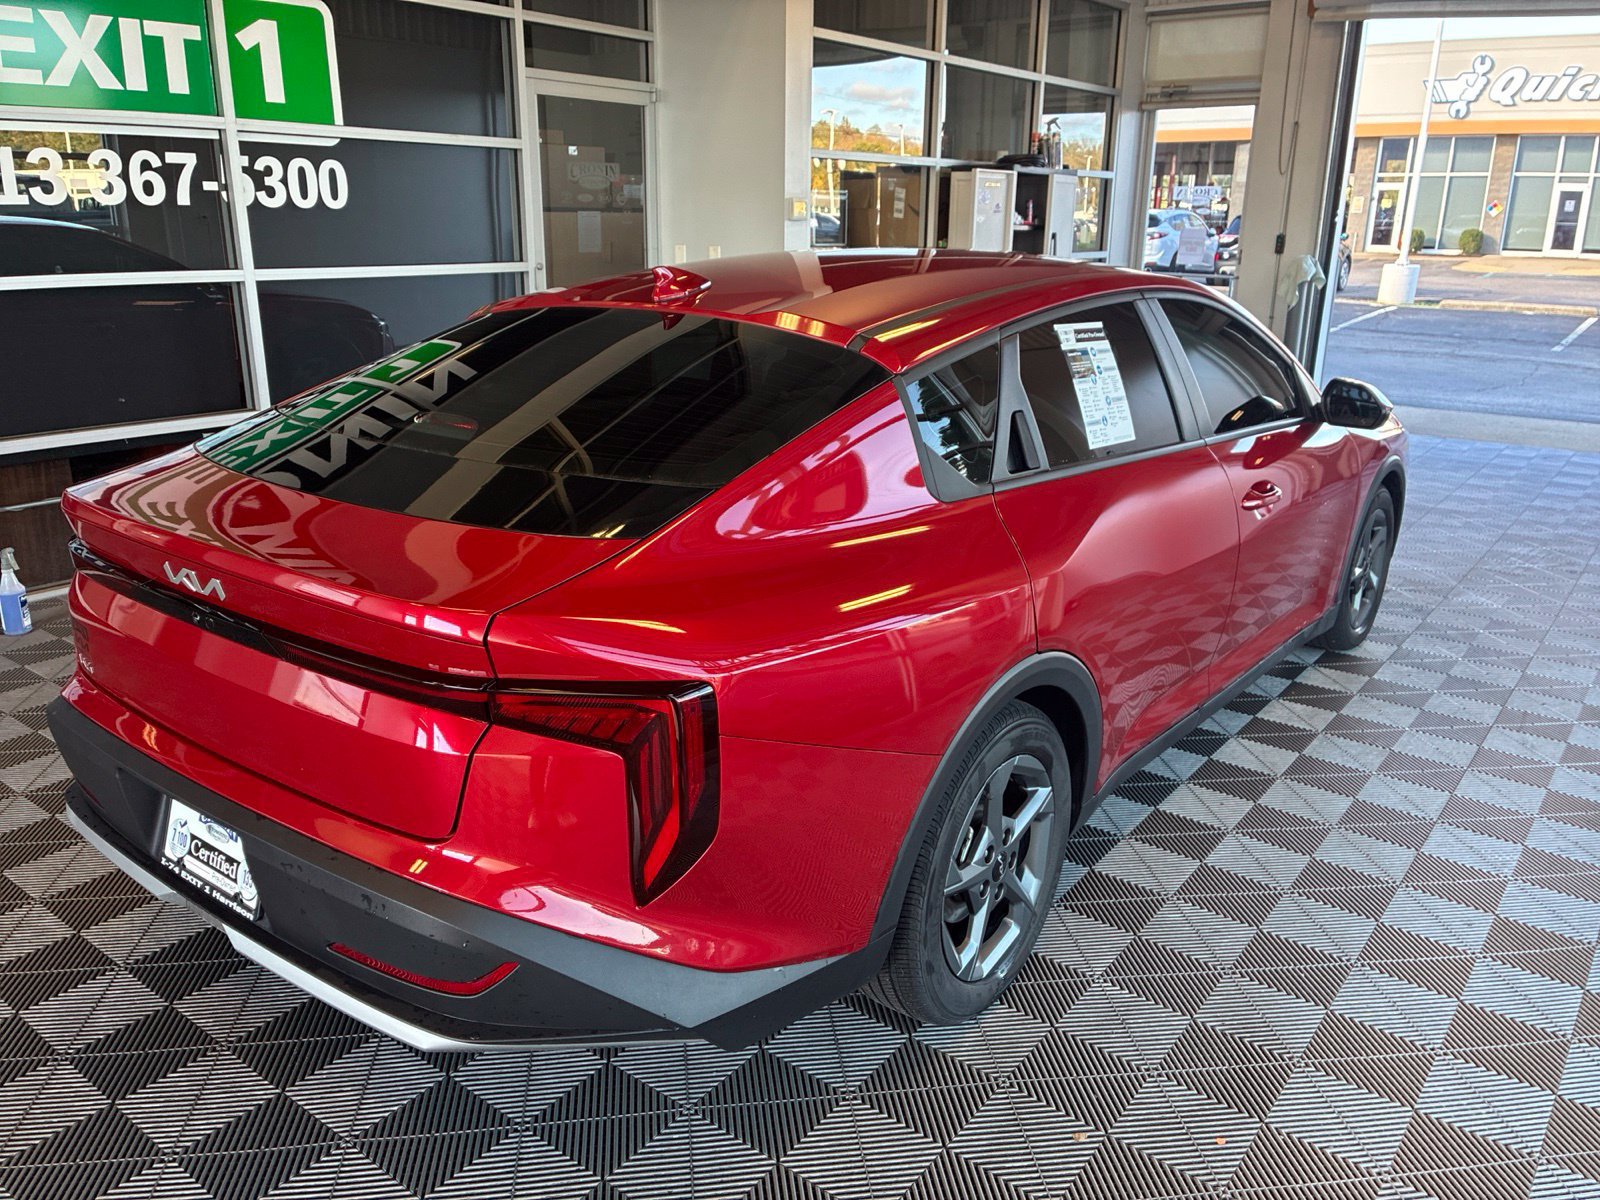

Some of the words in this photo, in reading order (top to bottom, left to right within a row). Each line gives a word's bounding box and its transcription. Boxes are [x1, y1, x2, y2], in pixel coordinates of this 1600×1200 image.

[0, 5, 201, 94] EXIT
[235, 19, 286, 104] 1
[163, 561, 226, 601] KIA
[191, 839, 238, 880] Certified
[161, 857, 180, 874] I-74
[181, 870, 203, 888] EXIT
[212, 889, 254, 921] Harrison
